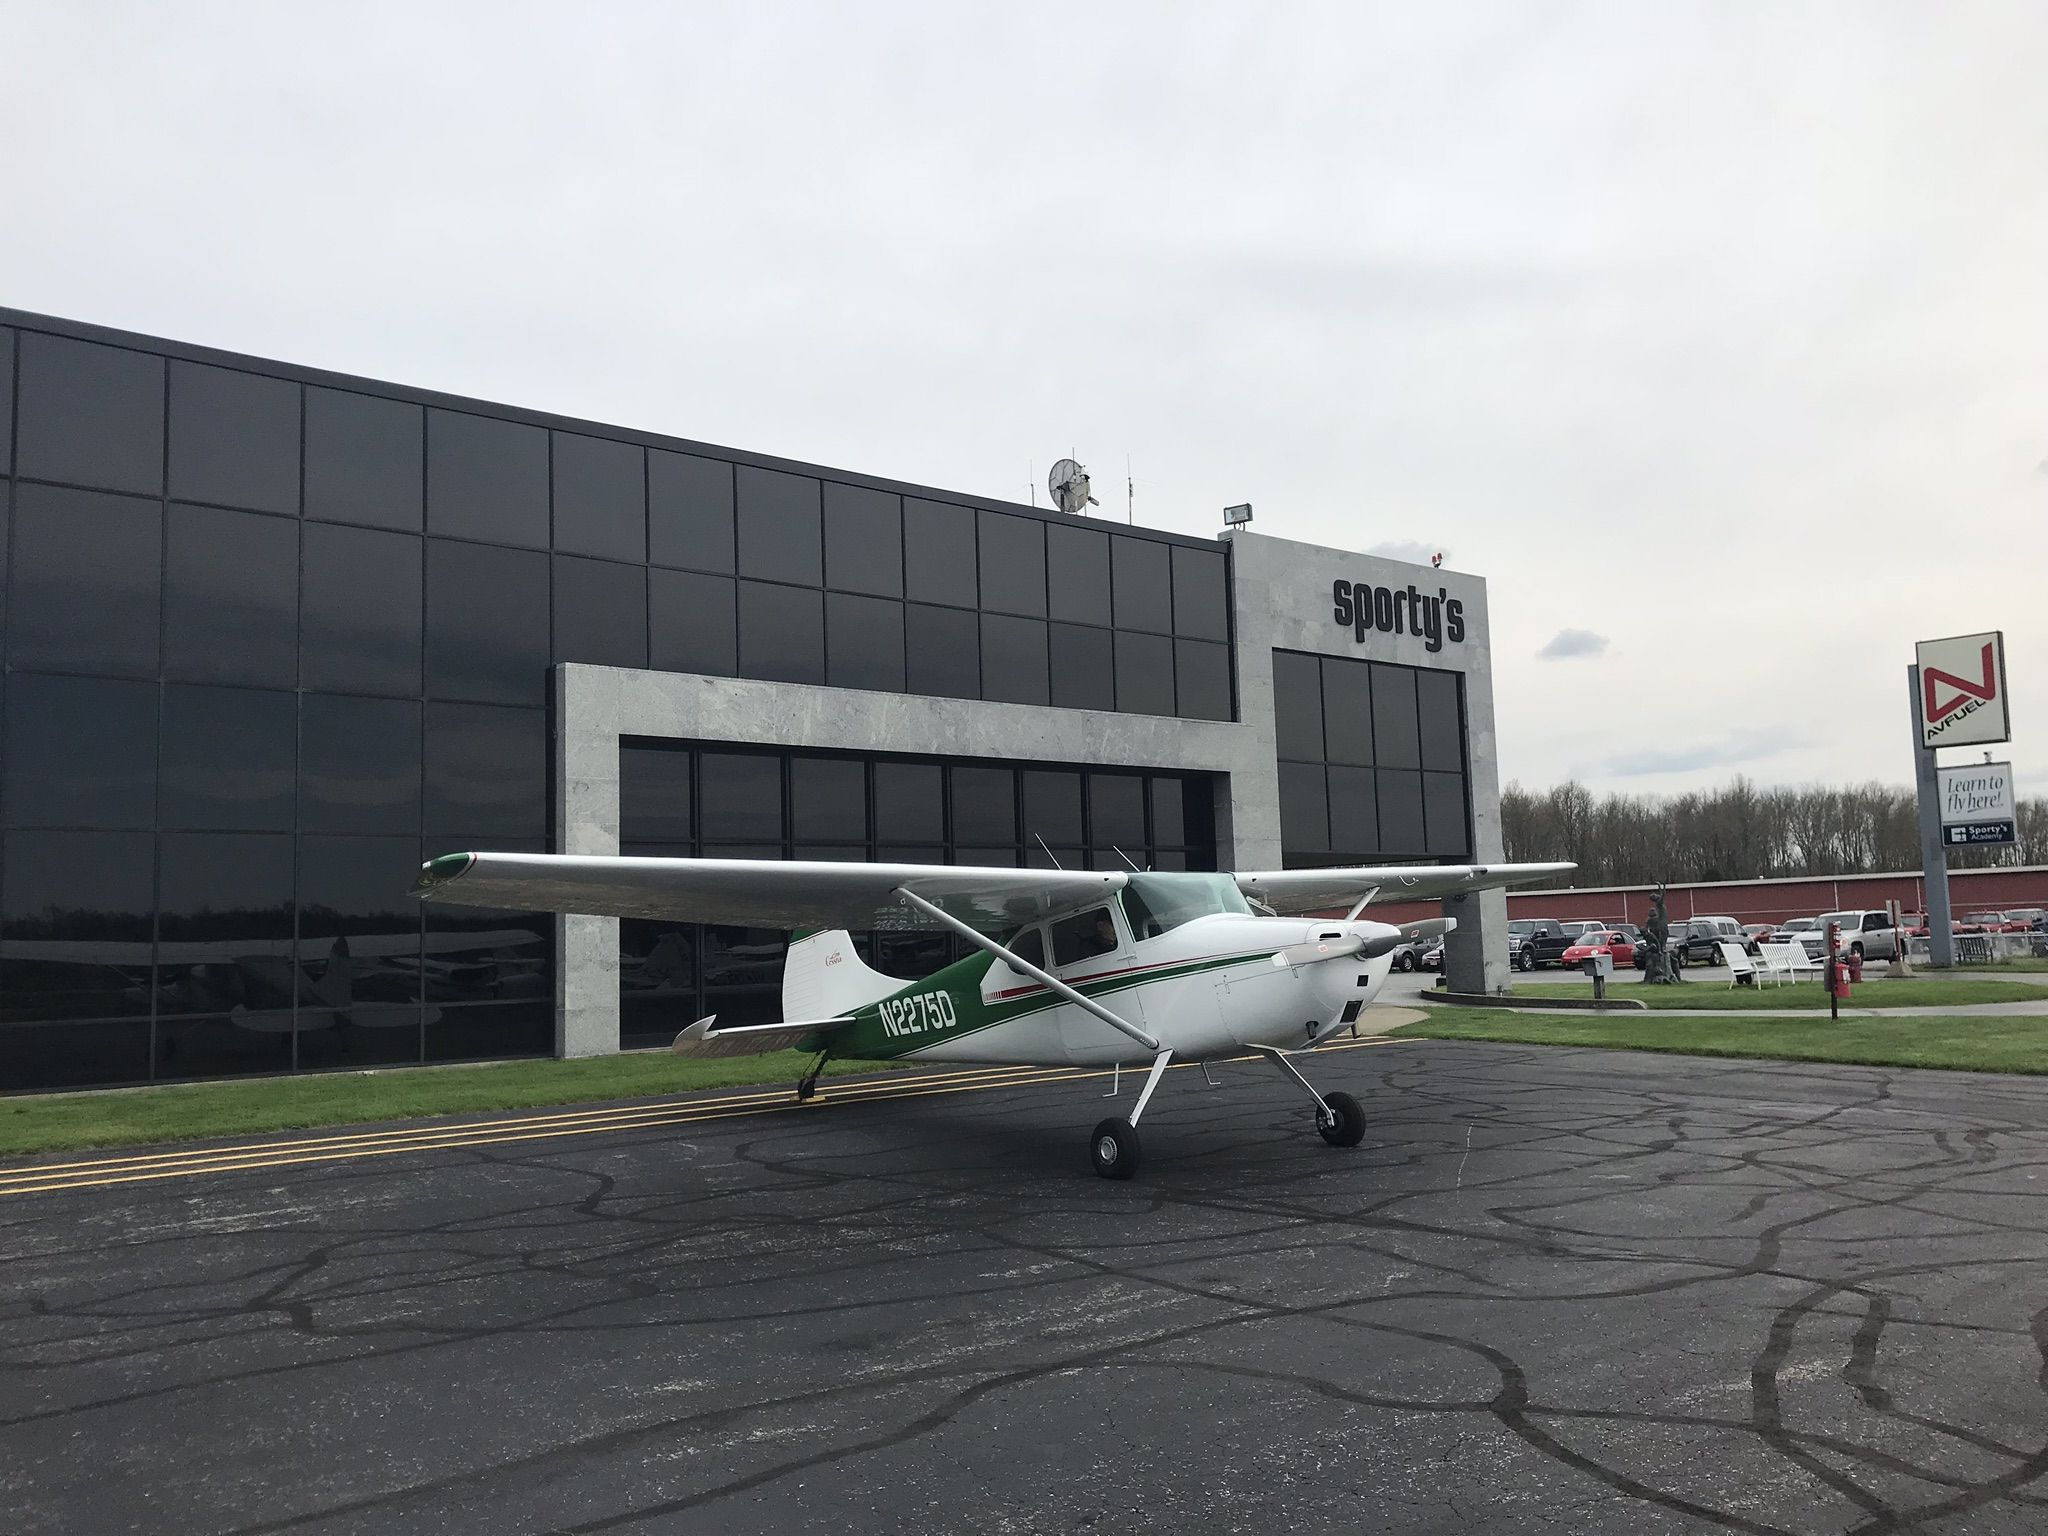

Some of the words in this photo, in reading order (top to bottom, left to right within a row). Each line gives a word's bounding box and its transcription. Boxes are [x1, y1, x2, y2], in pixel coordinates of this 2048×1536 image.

[1333, 579, 1465, 653] sporty's
[1927, 699, 1986, 740] AVFUEL
[1947, 777, 1986, 793] Learn
[1989, 775, 2004, 790] to
[1947, 793, 1966, 814] fly
[1967, 791, 2004, 810] here!
[1968, 823, 2008, 835] Sporty's
[1971, 832, 2003, 841] Academy
[878, 989, 957, 1038] N2275D
